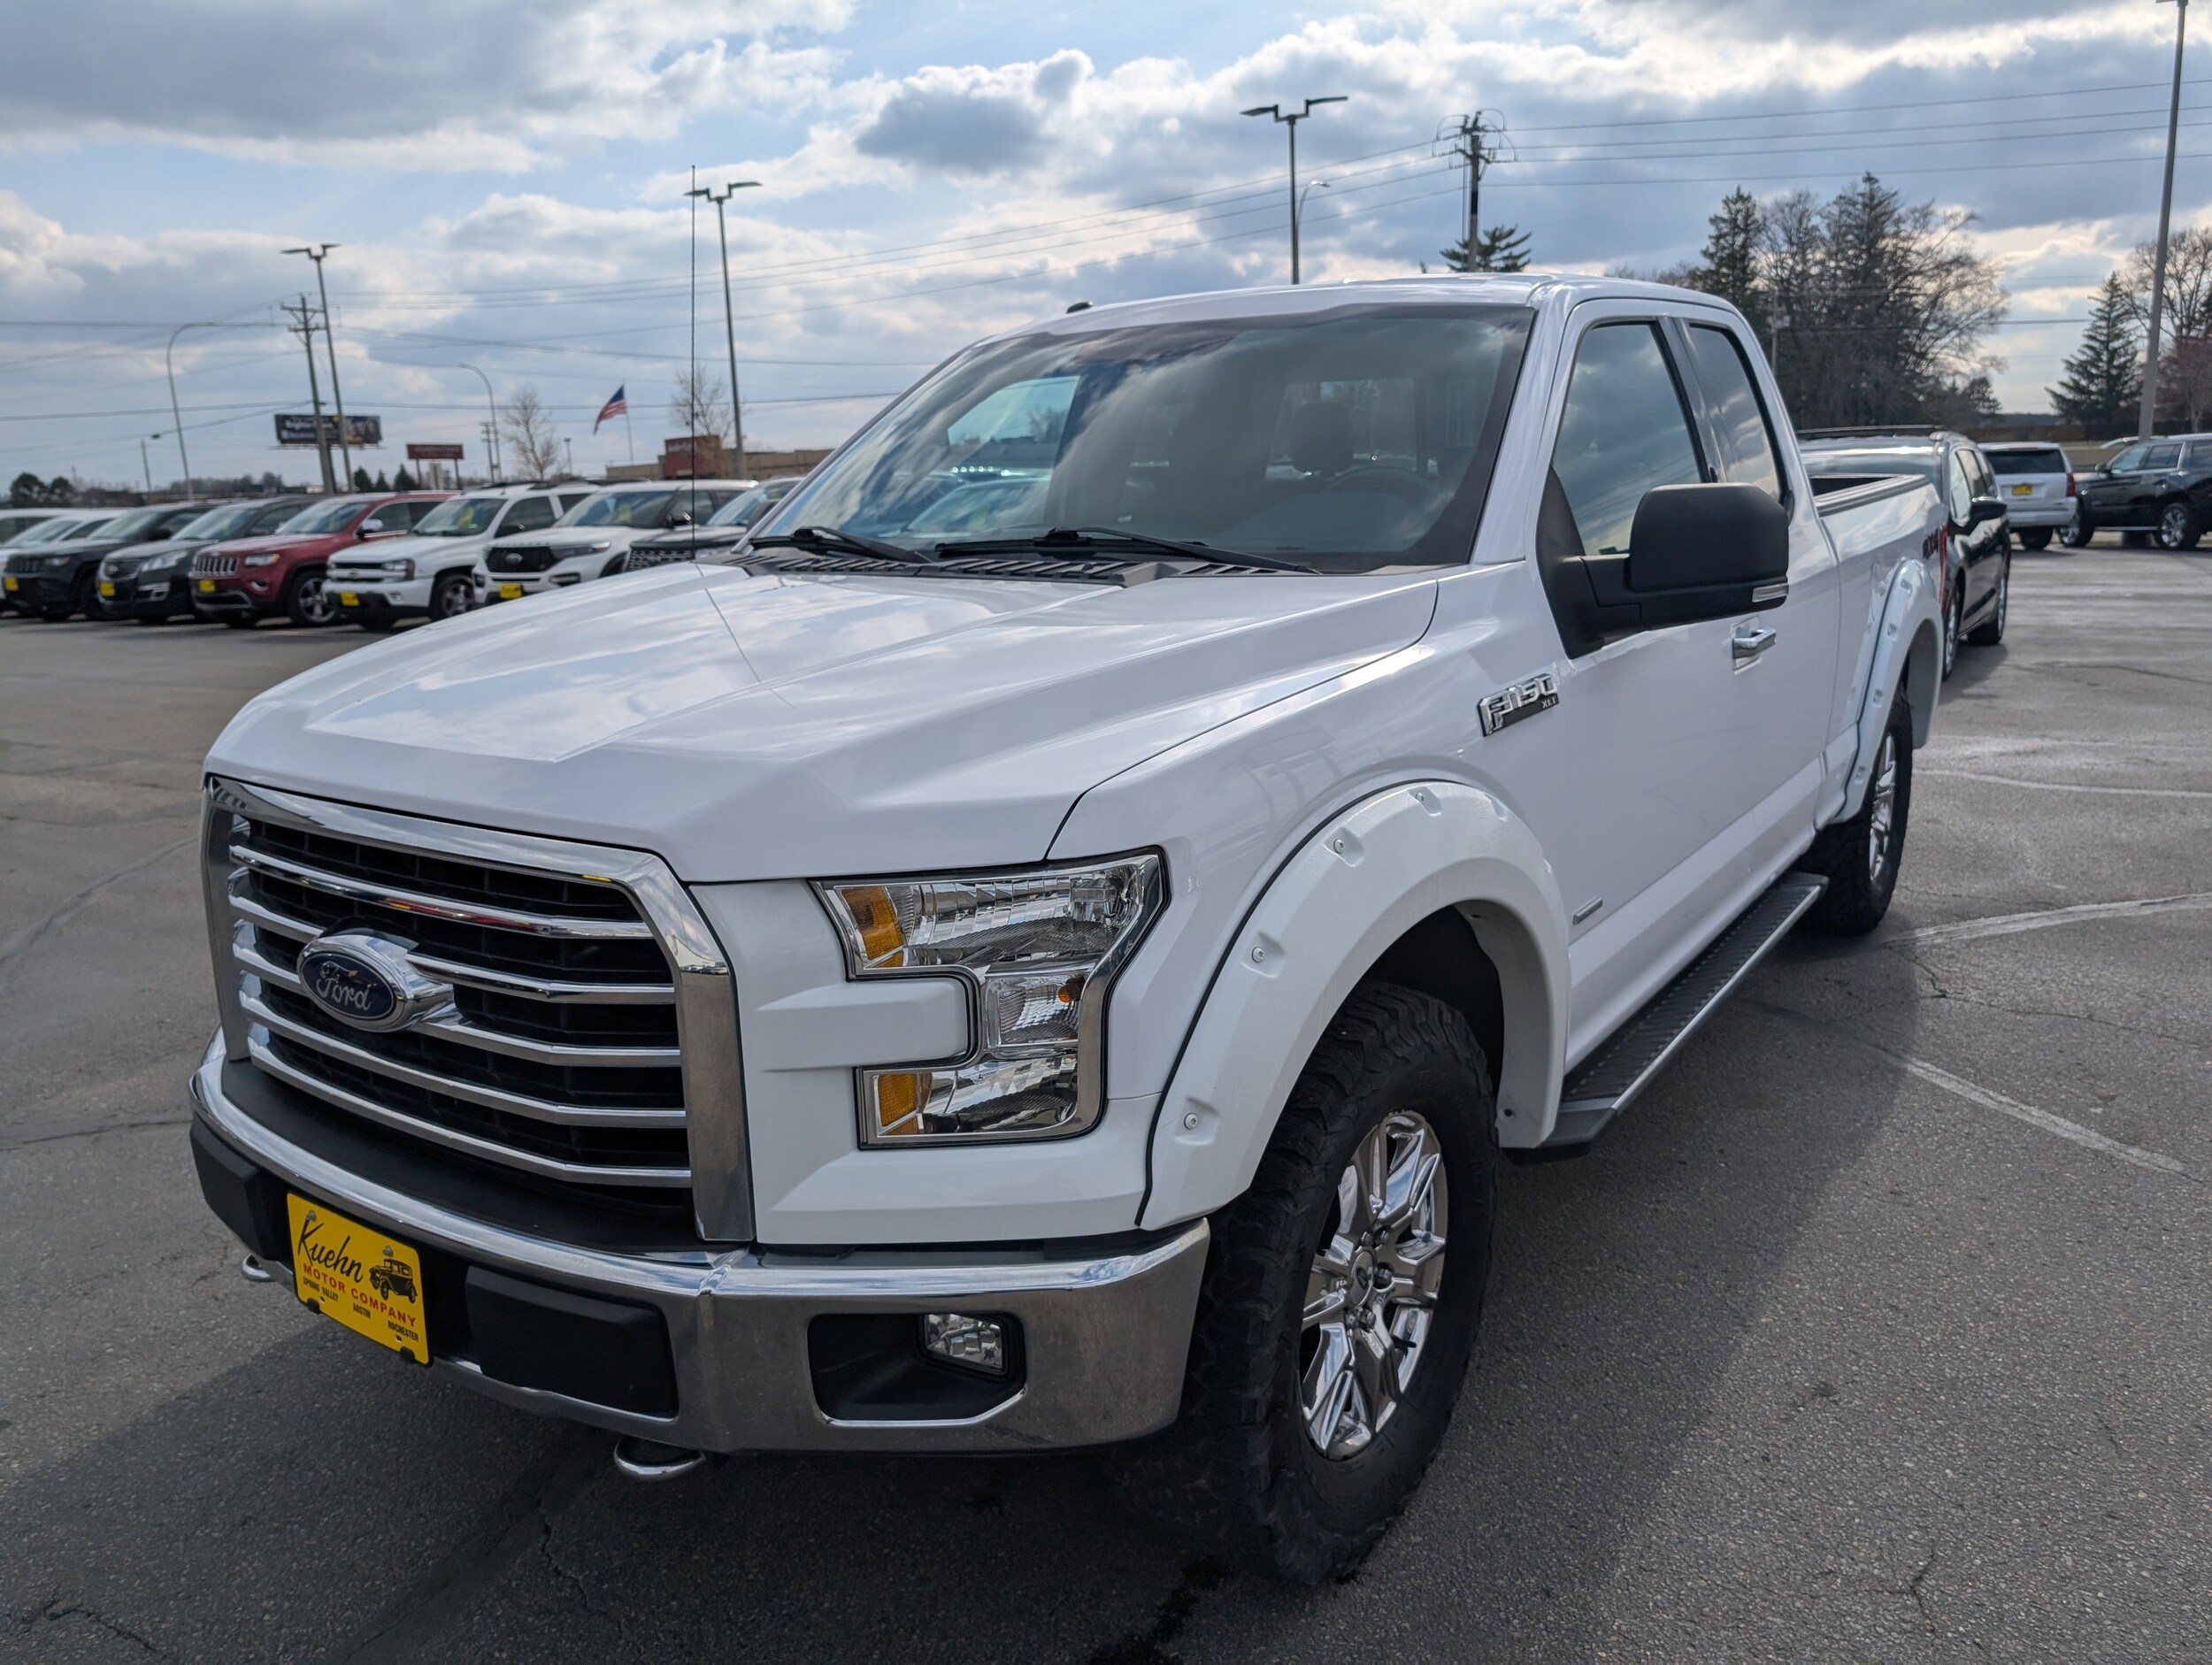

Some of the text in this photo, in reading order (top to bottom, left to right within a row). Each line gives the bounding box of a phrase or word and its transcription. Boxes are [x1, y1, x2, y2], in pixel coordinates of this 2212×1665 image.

[1541, 696, 1557, 709] XLT
[316, 961, 373, 1011] Ford
[297, 1217, 364, 1284] Kuehn
[303, 1263, 417, 1327] MOTOR COMPANY
[303, 1276, 419, 1342] SPRING VALLEY AUSTIN ROCHESTER
